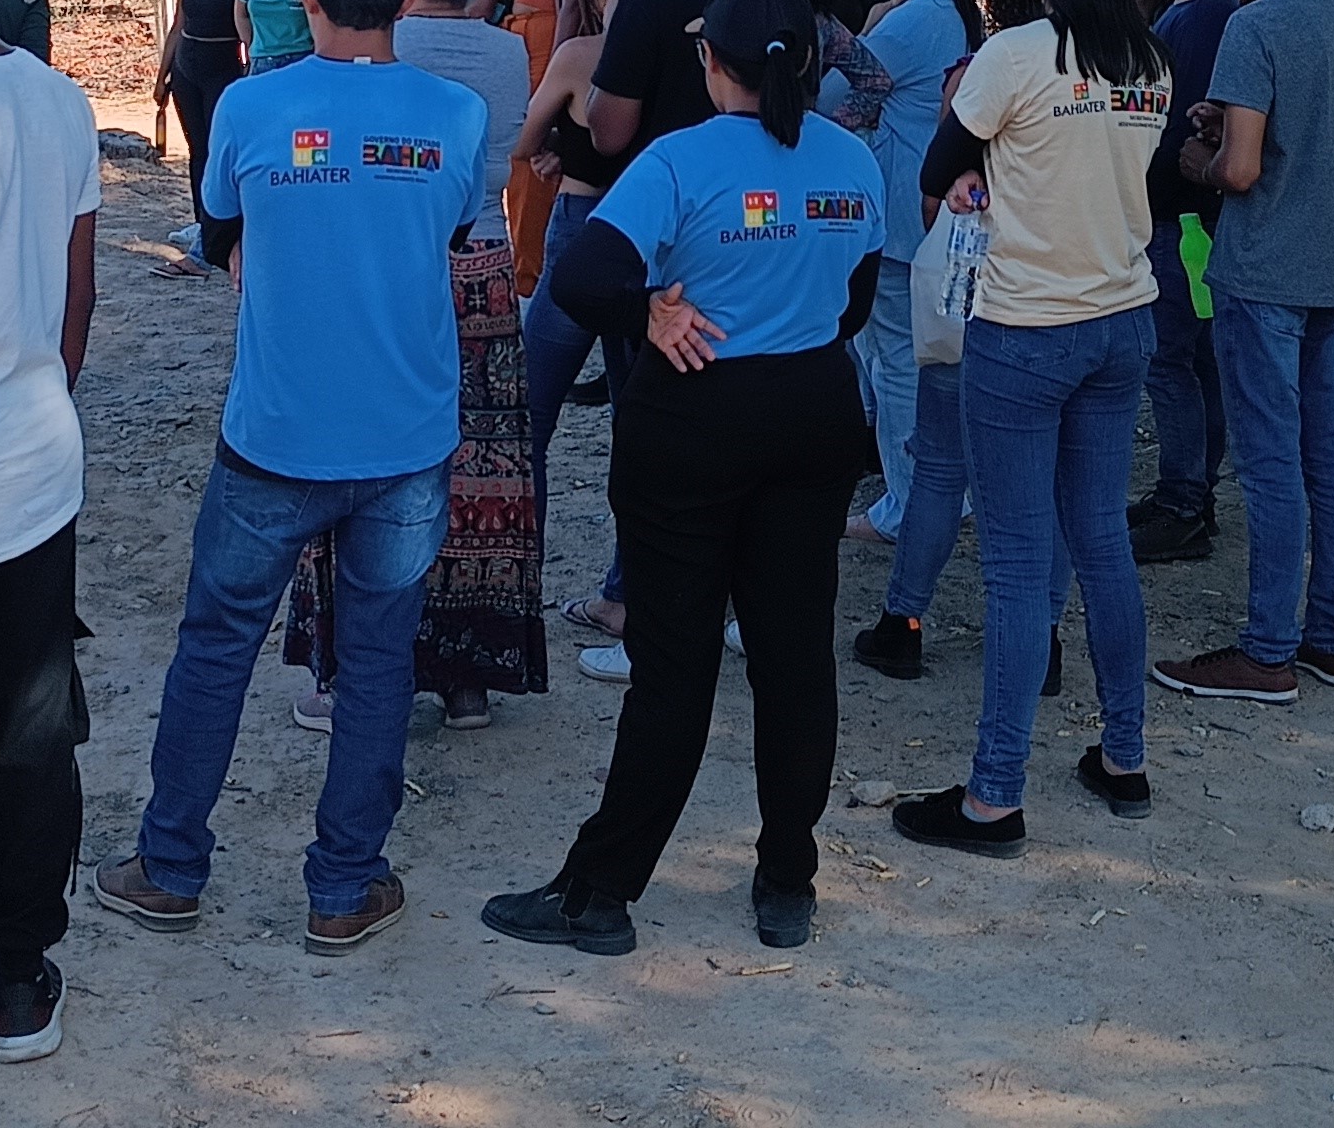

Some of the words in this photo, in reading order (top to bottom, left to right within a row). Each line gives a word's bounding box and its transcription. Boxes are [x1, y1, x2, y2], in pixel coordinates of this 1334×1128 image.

[1053, 101, 1106, 117] BAHIATER
[362, 144, 441, 171] BAHIA
[270, 168, 350, 186] BAHIATER
[806, 199, 864, 220] BAHIA
[721, 224, 796, 243] BAHIATER
